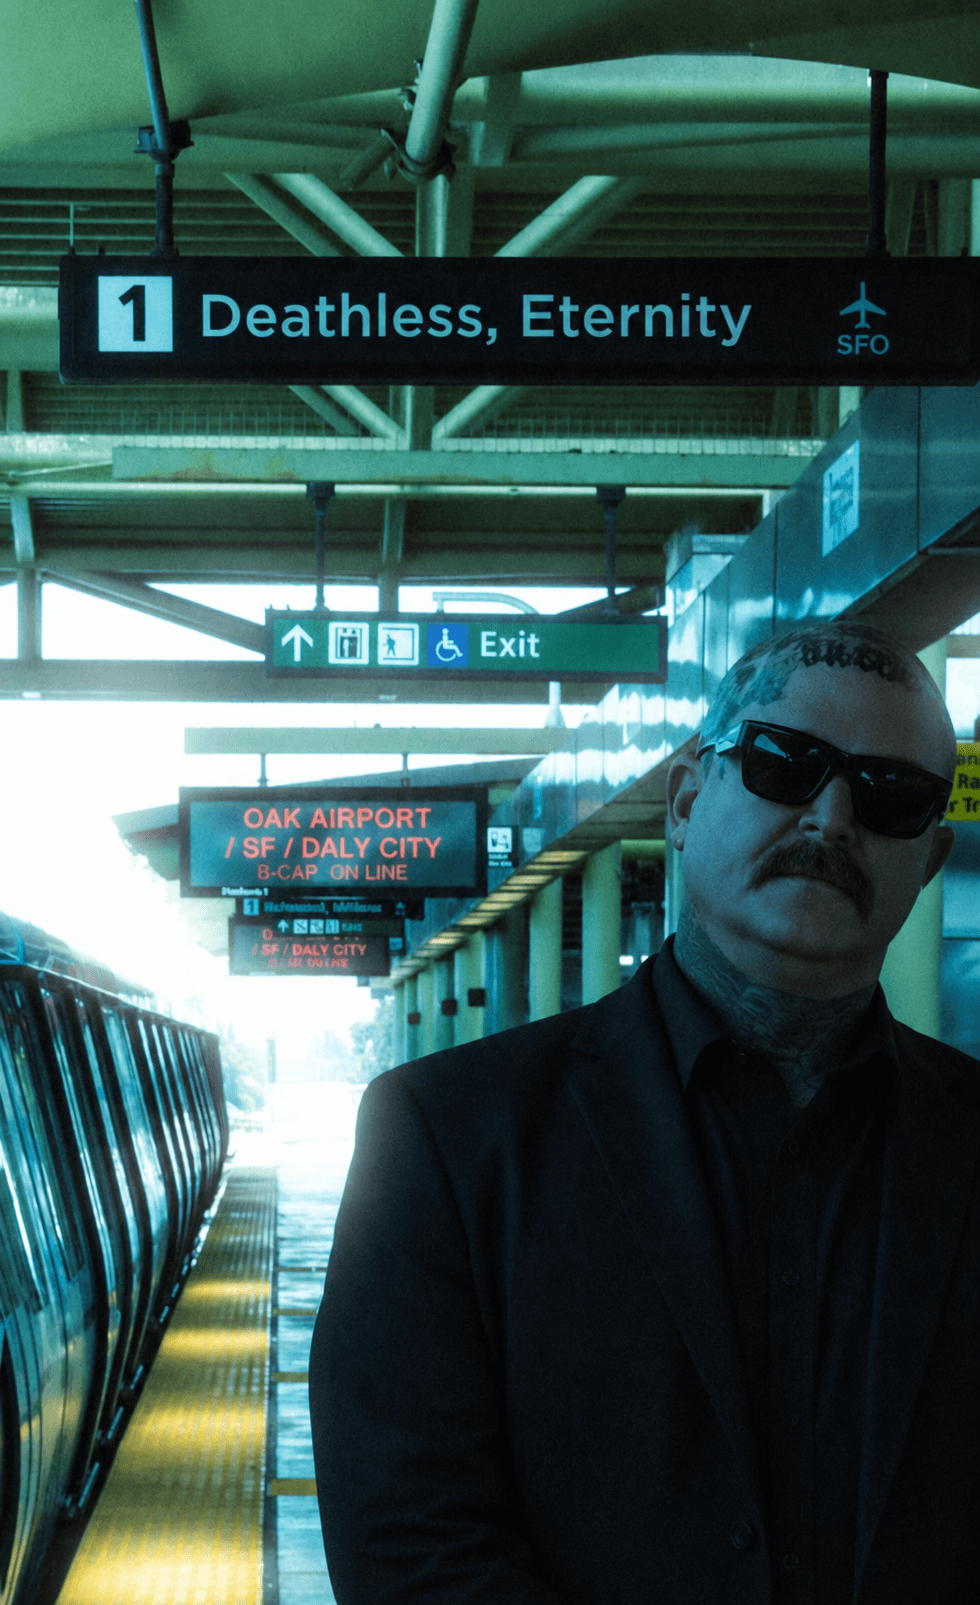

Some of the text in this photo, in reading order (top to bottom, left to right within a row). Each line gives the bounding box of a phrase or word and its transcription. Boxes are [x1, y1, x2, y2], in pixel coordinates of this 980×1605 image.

[119, 285, 752, 347] 1 Deathless, Eternity
[836, 334, 890, 356] SFO
[480, 629, 540, 659] Exit
[243, 807, 432, 829] OAK AIRPORT
[225, 836, 442, 859] / SF / DALY CITY
[330, 864, 359, 881] ON
[365, 864, 408, 882] LINE
[262, 944, 280, 956] SF
[292, 944, 330, 956] DALY
[333, 944, 367, 956] CITY
